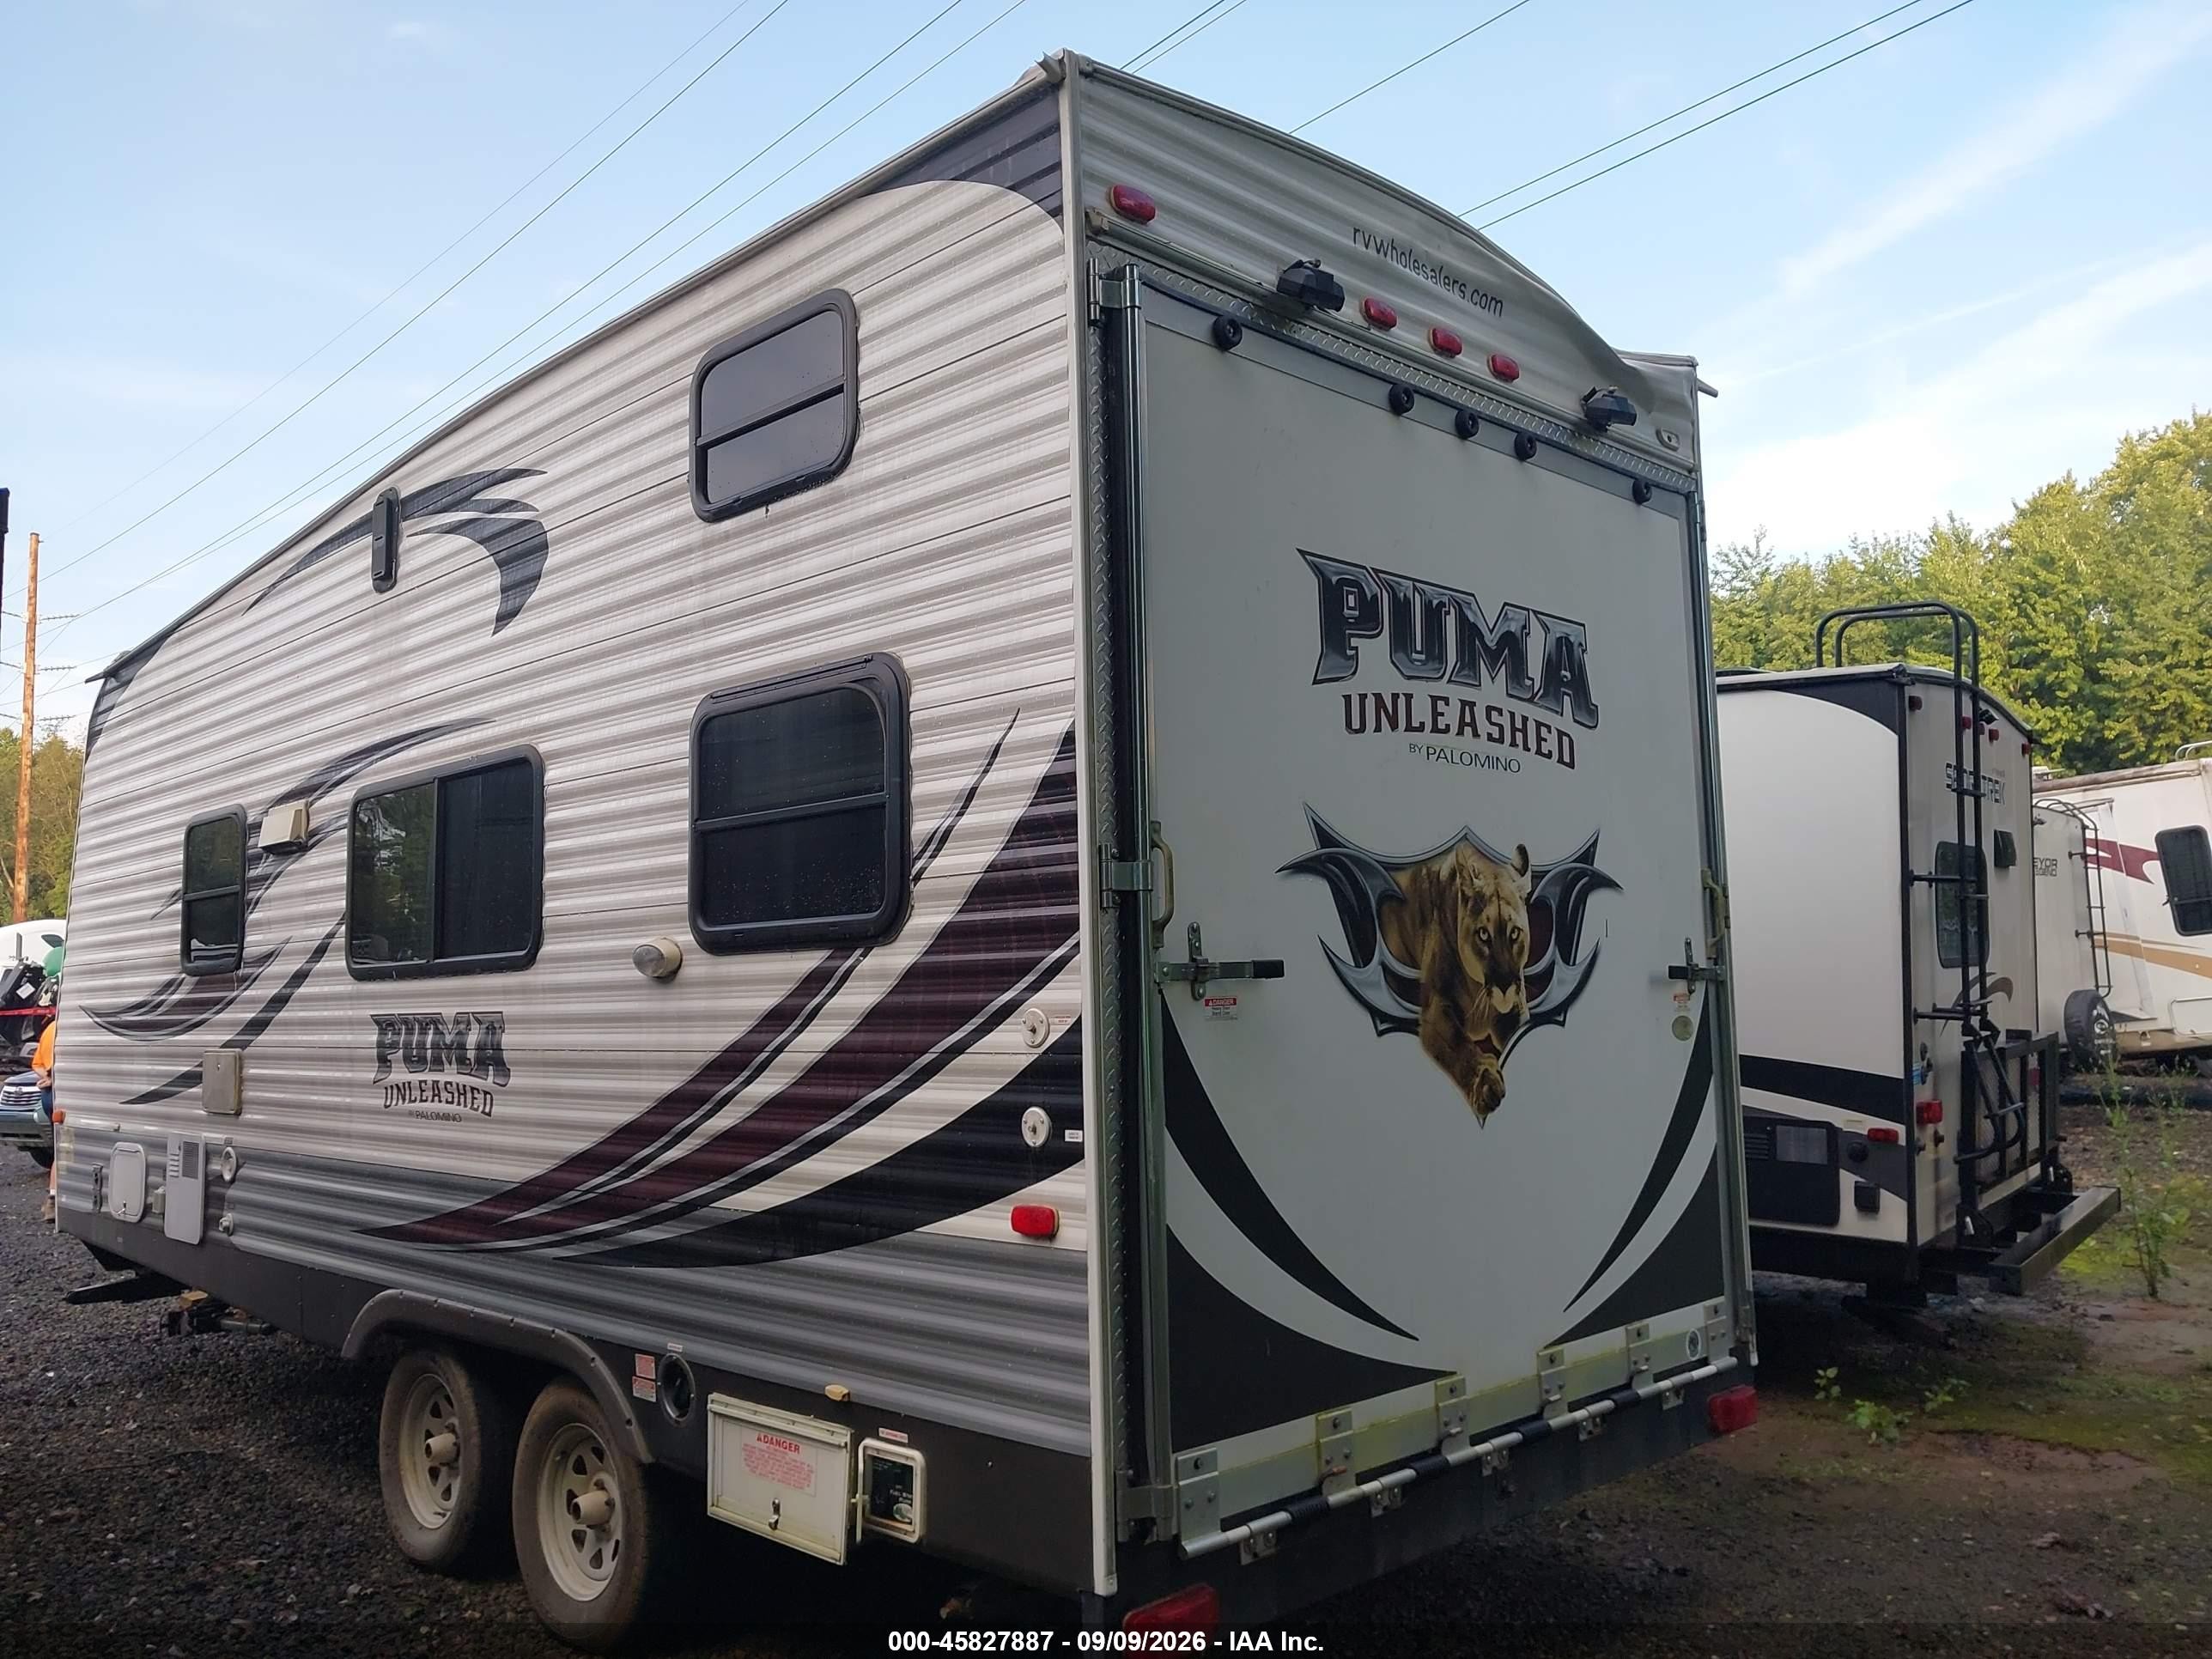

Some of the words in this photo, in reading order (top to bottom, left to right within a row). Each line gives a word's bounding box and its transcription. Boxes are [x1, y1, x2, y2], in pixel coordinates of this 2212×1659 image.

[1352, 226, 1504, 318] rvwholesalers.com
[1295, 547, 1600, 730] PUMA
[1342, 692, 1577, 770] UNLEASHED
[1408, 743, 1424, 755] BY
[1425, 745, 1521, 774] PALOMINO
[369, 1011, 511, 1087] PUMA
[383, 1079, 494, 1118] UNLEASHED
[415, 1109, 462, 1123] PALOMINO
[763, 1434, 800, 1455] DANGER
